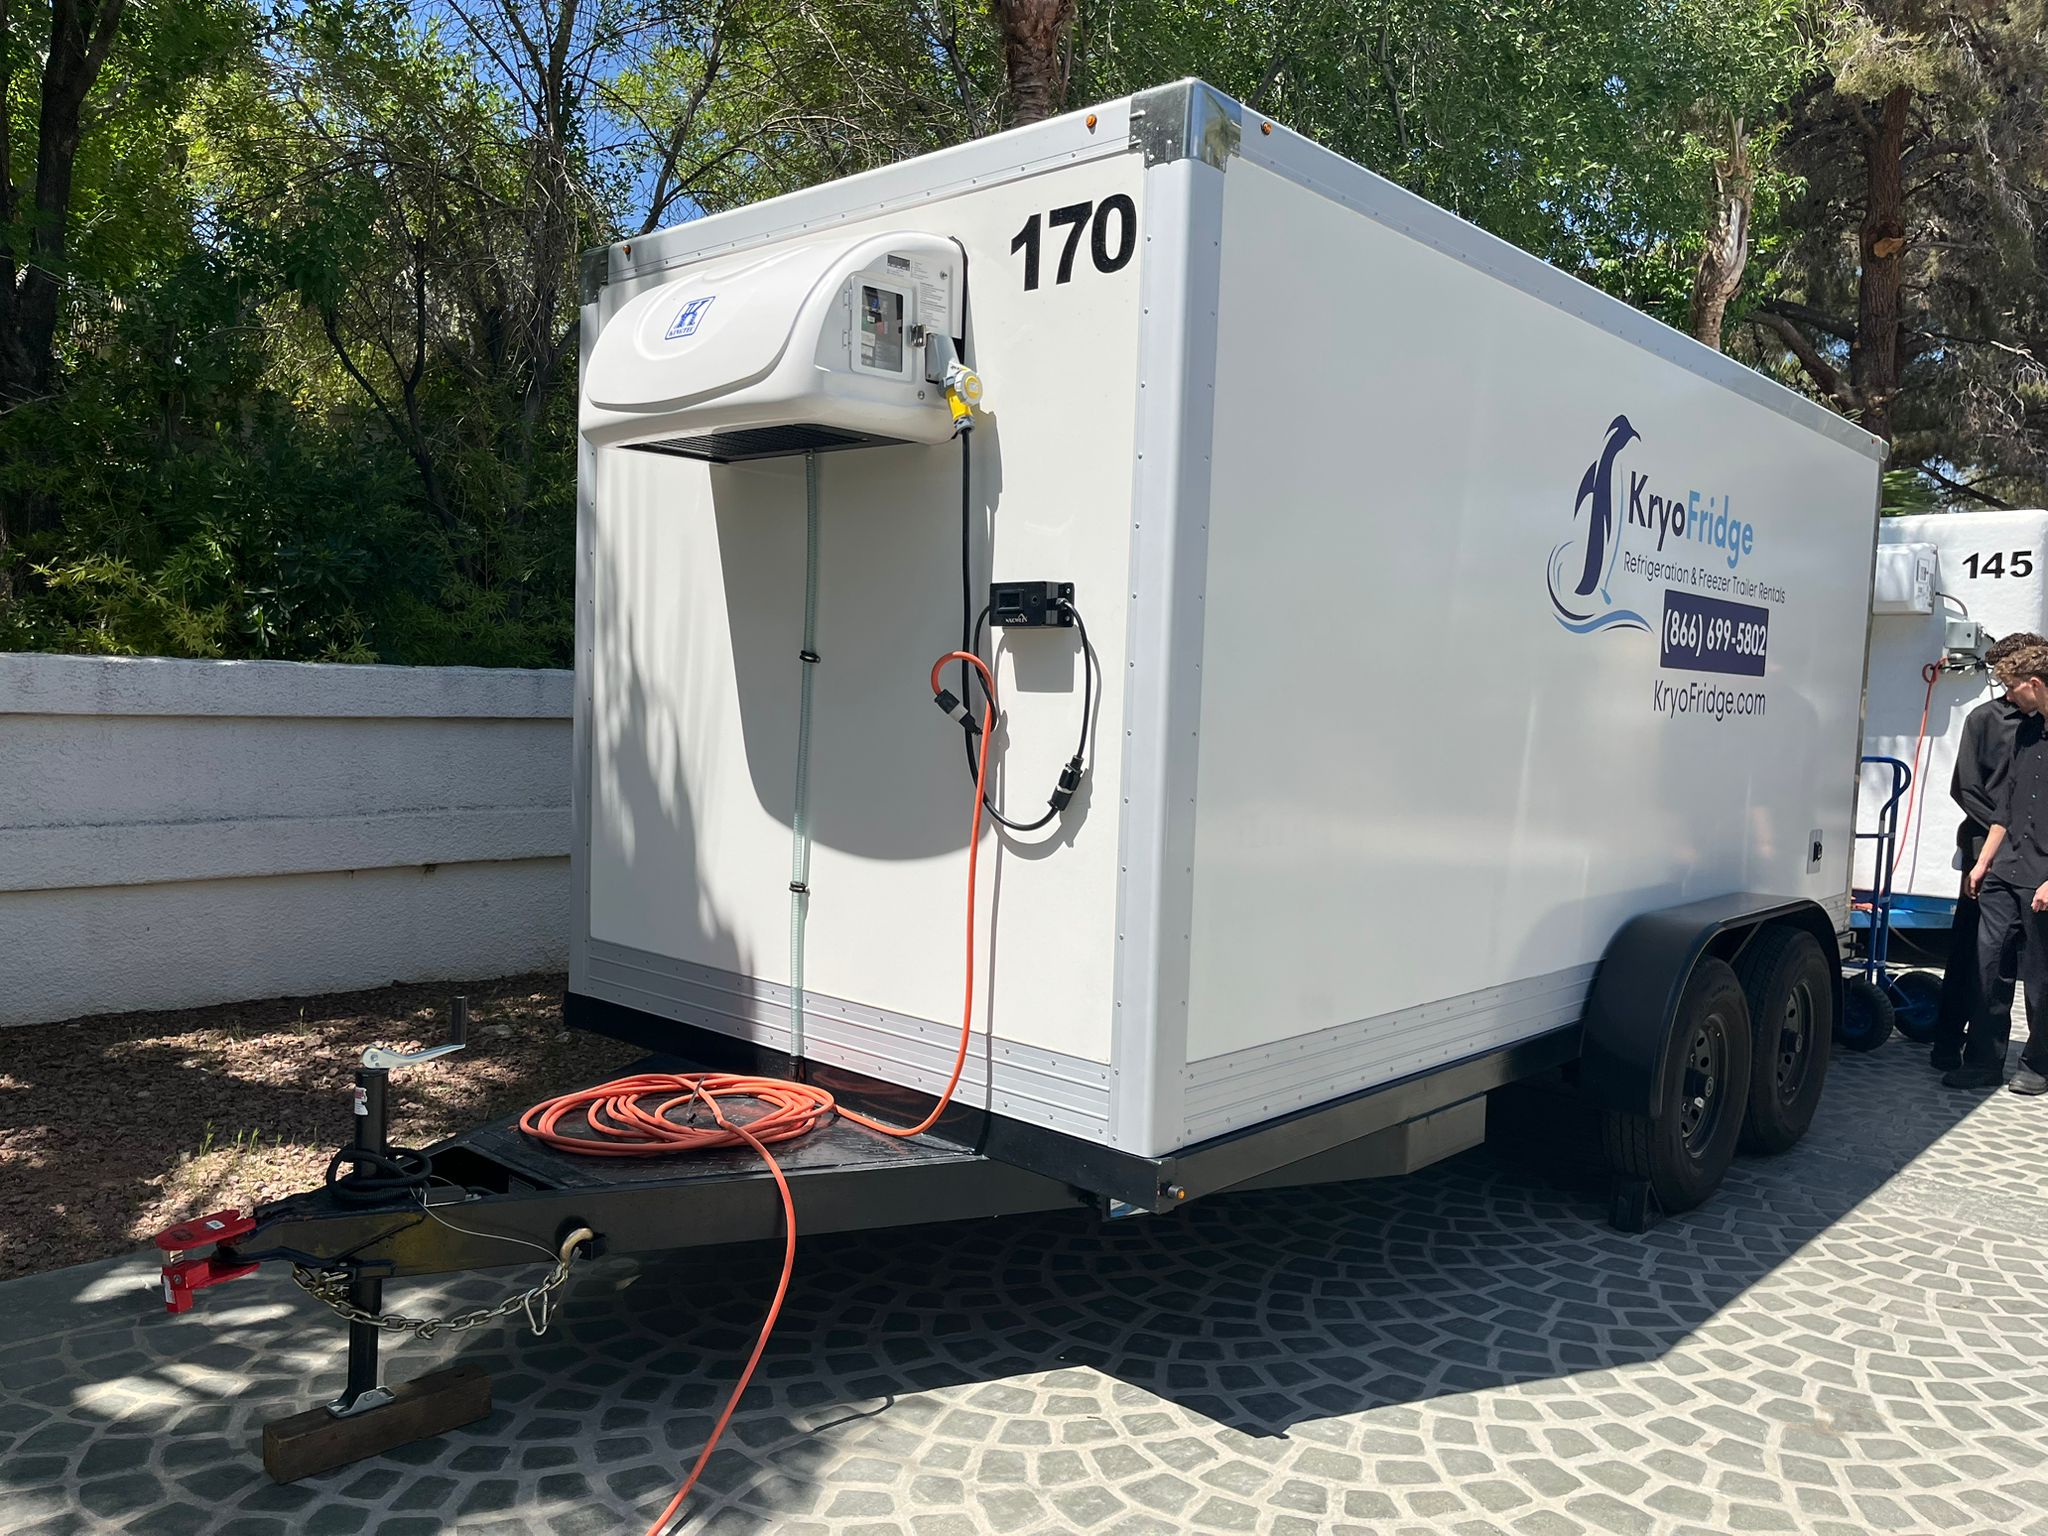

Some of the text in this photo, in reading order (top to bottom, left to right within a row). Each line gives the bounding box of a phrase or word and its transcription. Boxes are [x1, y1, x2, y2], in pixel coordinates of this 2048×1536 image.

[1010, 193, 1137, 292] 170
[1628, 470, 1754, 569] KryoFridge
[1623, 551, 1786, 604] Refrigeration & Freezer Trailer Rentals
[1962, 550, 2033, 579] 145
[1664, 608, 1767, 657] (866) 699-5802
[1653, 680, 1766, 722] KryoFridge.com
